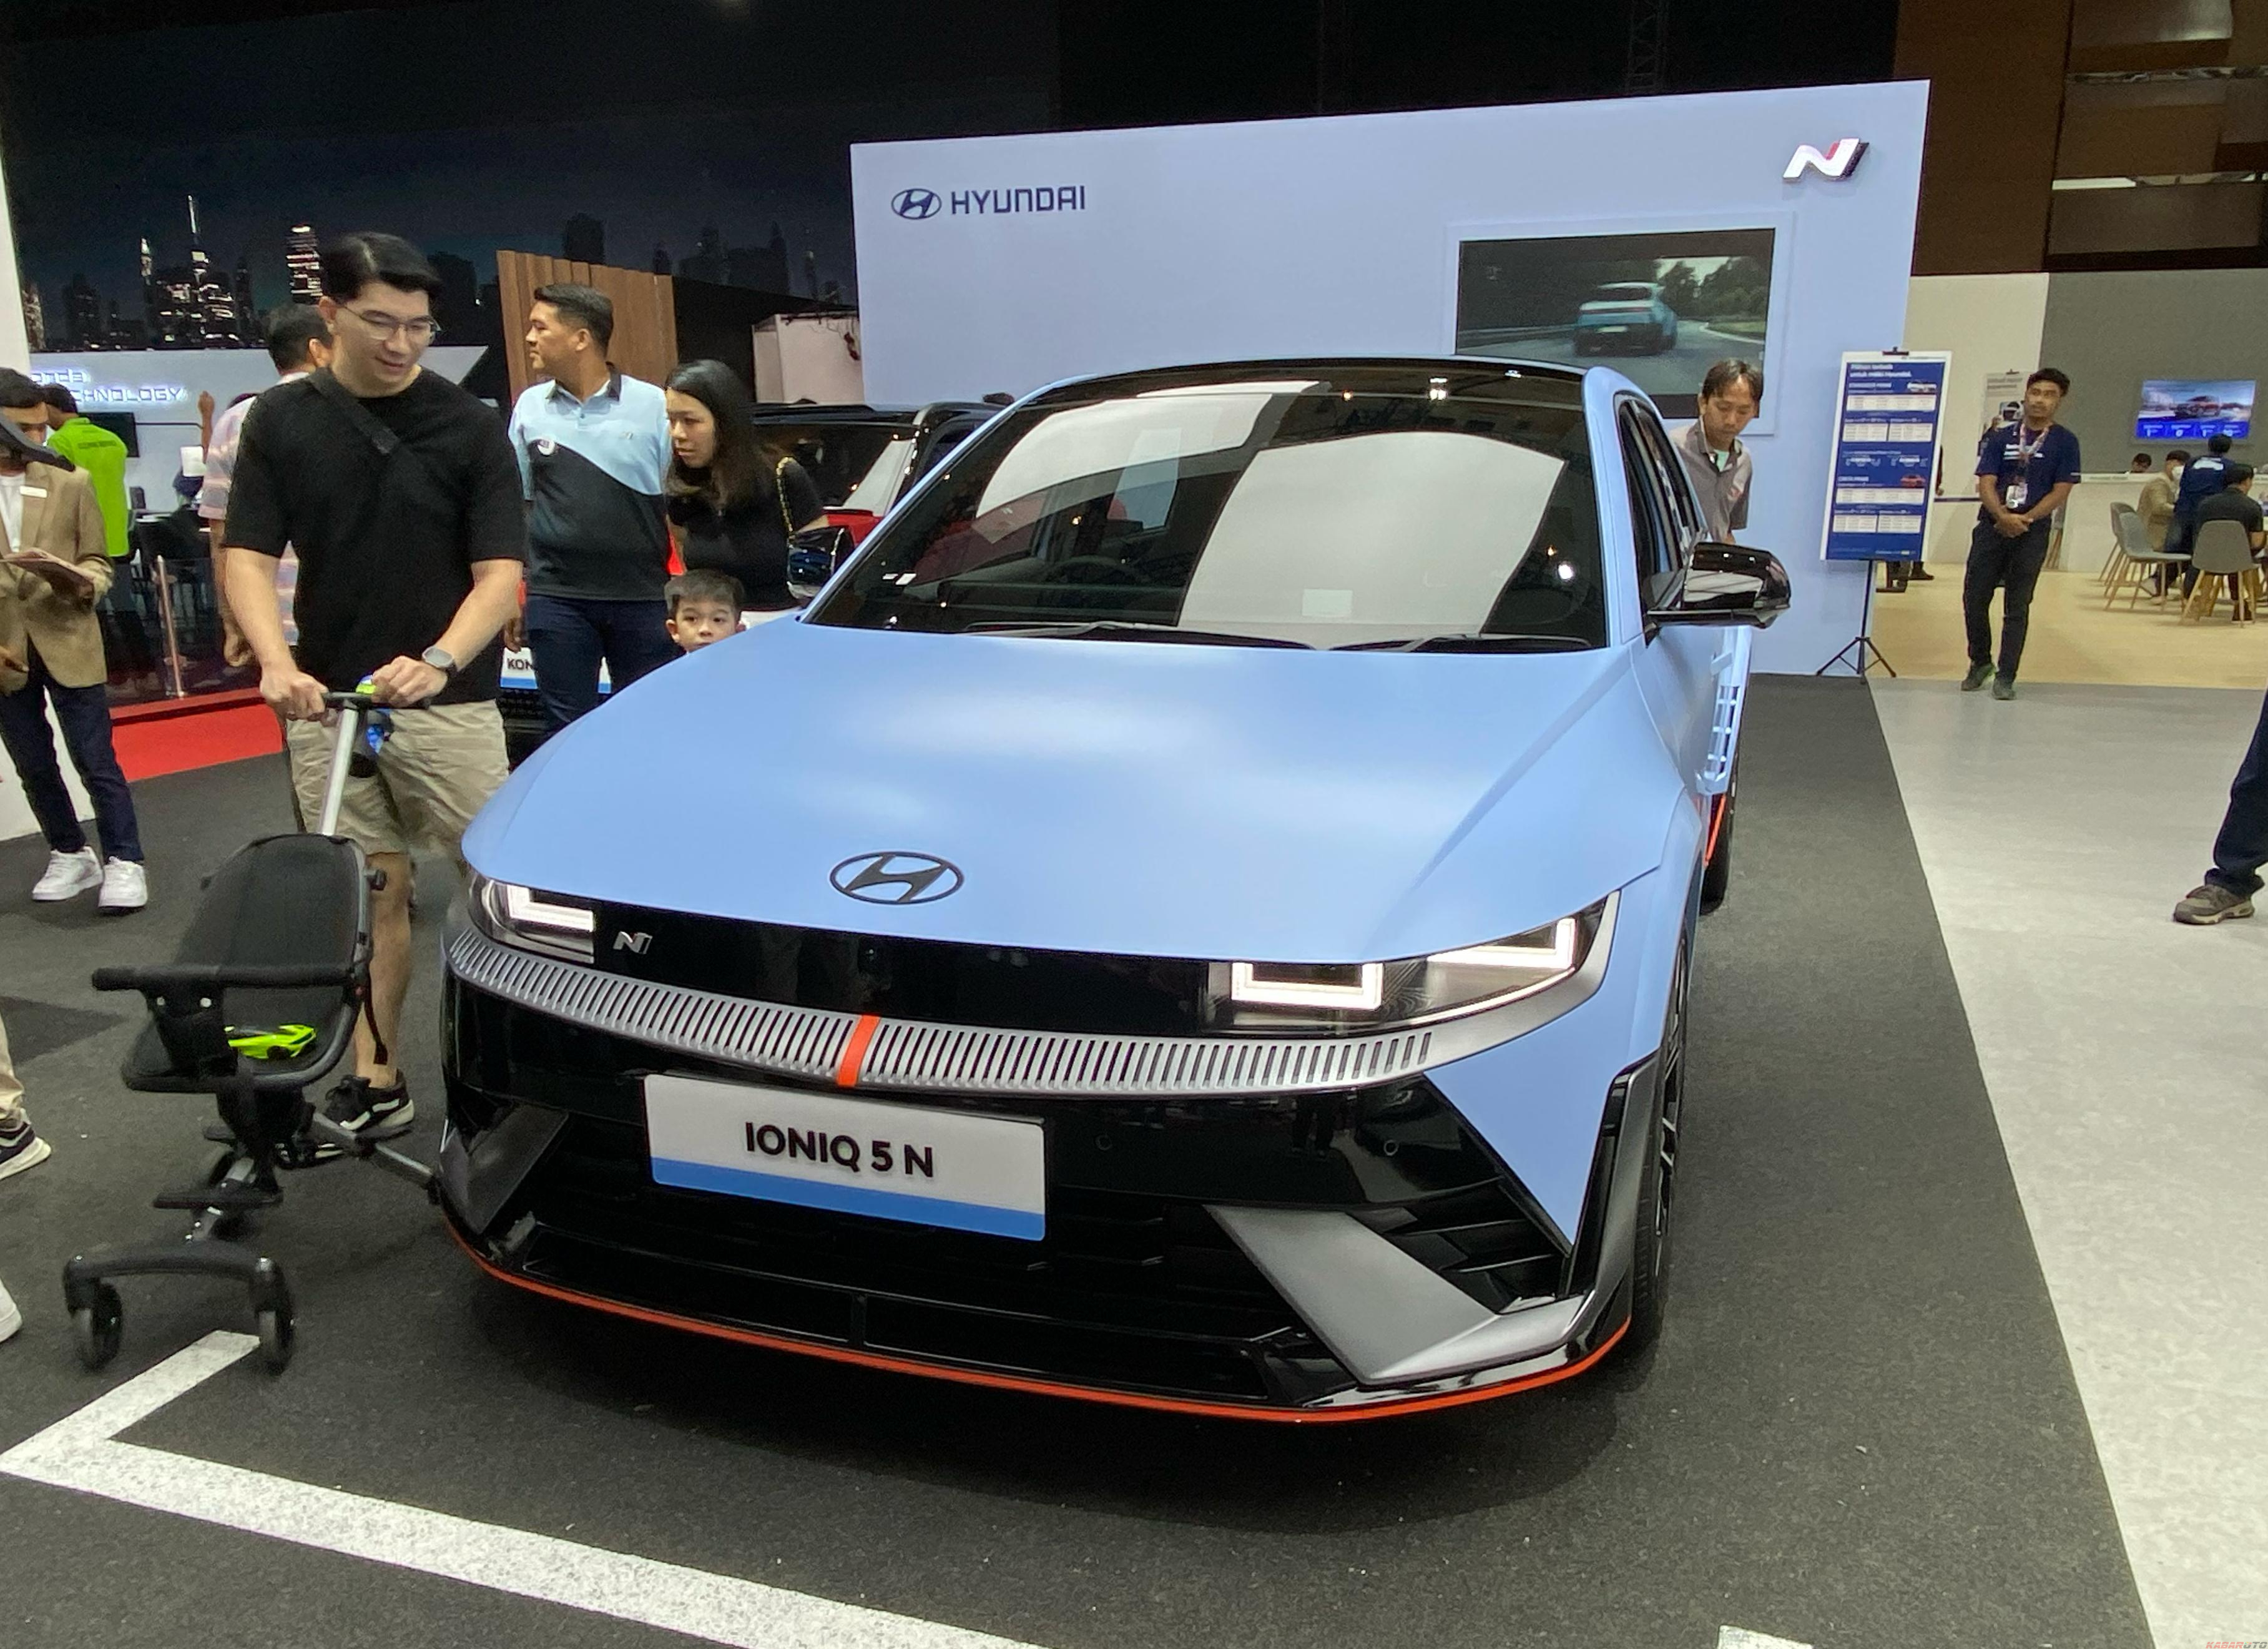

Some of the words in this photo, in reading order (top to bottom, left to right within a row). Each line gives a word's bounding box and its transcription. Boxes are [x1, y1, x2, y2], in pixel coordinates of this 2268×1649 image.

[951, 185, 1085, 215] HYUNDAI
[745, 1122, 861, 1173] IONIQ
[871, 1140, 893, 1172] 5
[904, 1144, 933, 1178] N
